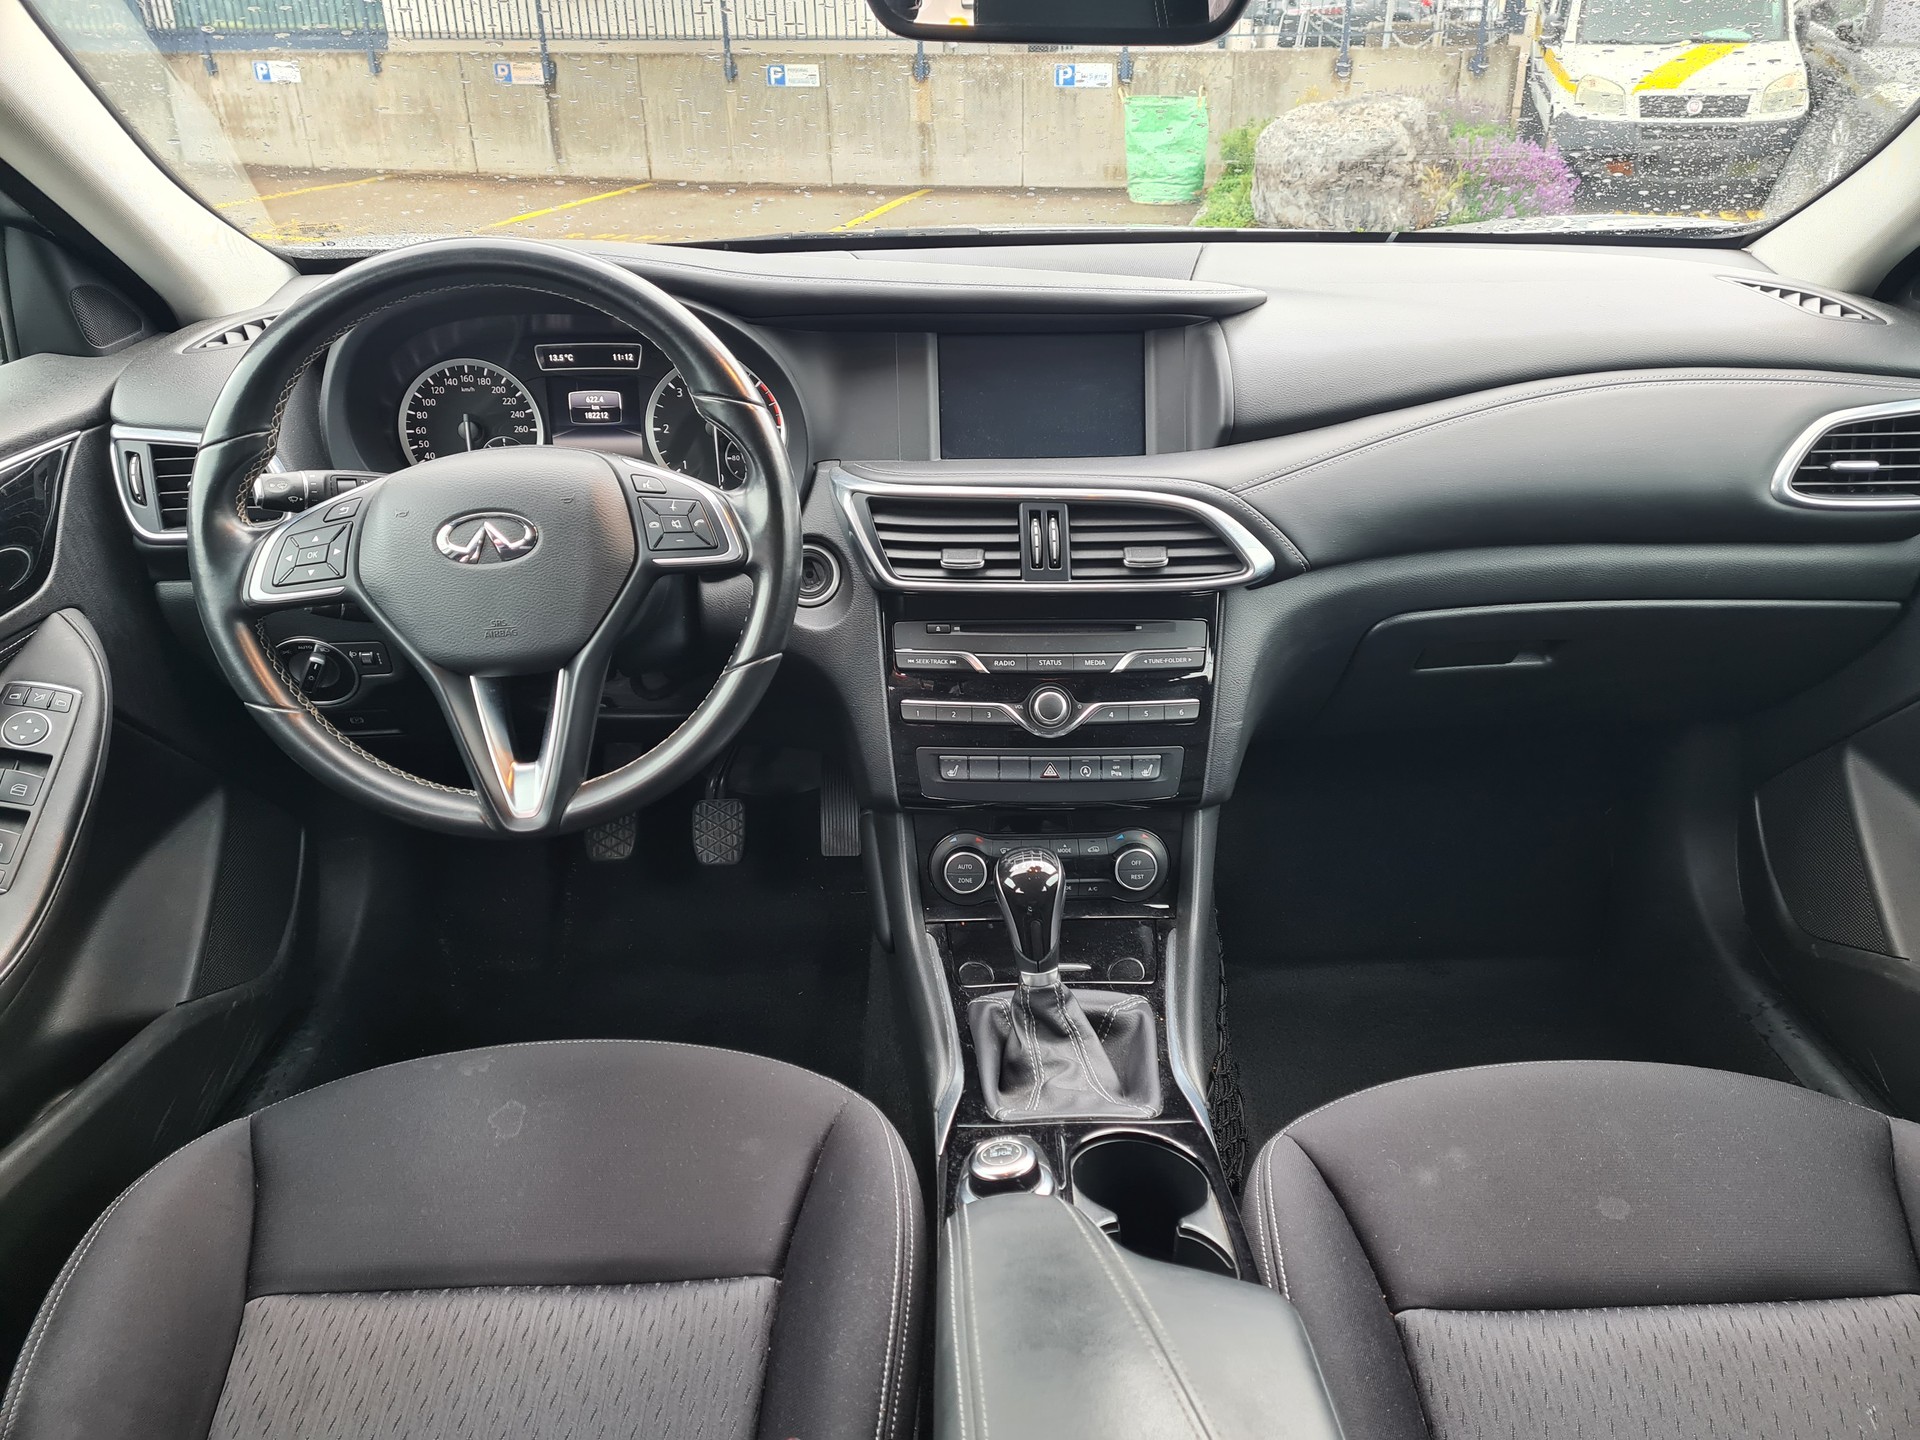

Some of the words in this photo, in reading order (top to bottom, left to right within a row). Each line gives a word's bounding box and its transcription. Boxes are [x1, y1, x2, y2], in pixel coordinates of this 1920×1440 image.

[770, 66, 783, 85] P
[1058, 66, 1073, 86] P
[548, 353, 574, 362] 13.5°C
[612, 353, 634, 361] 11:12
[444, 378, 458, 386] 140
[460, 374, 474, 383] 160
[477, 378, 491, 386] 180
[431, 386, 445, 394] 120
[491, 386, 506, 394] 200
[676, 387, 683, 398] 3
[421, 398, 436, 407] 100
[502, 397, 517, 406] 220
[585, 395, 604, 403] 622.4
[416, 411, 428, 420] 80
[510, 410, 525, 419] 240
[584, 411, 609, 419] 182212
[415, 427, 427, 435] 60
[513, 426, 529, 434] 260
[663, 423, 670, 434] 2
[418, 440, 430, 449] 50
[424, 452, 436, 460] 40
[731, 454, 741, 462] 80
[682, 460, 687, 470] 1
[306, 550, 319, 560] OK
[993, 659, 1016, 667] RADIO
[1038, 658, 1062, 667] STATUS
[1084, 658, 1106, 667] MEDIA
[986, 711, 992, 719] 3
[1179, 708, 1185, 716] 6
